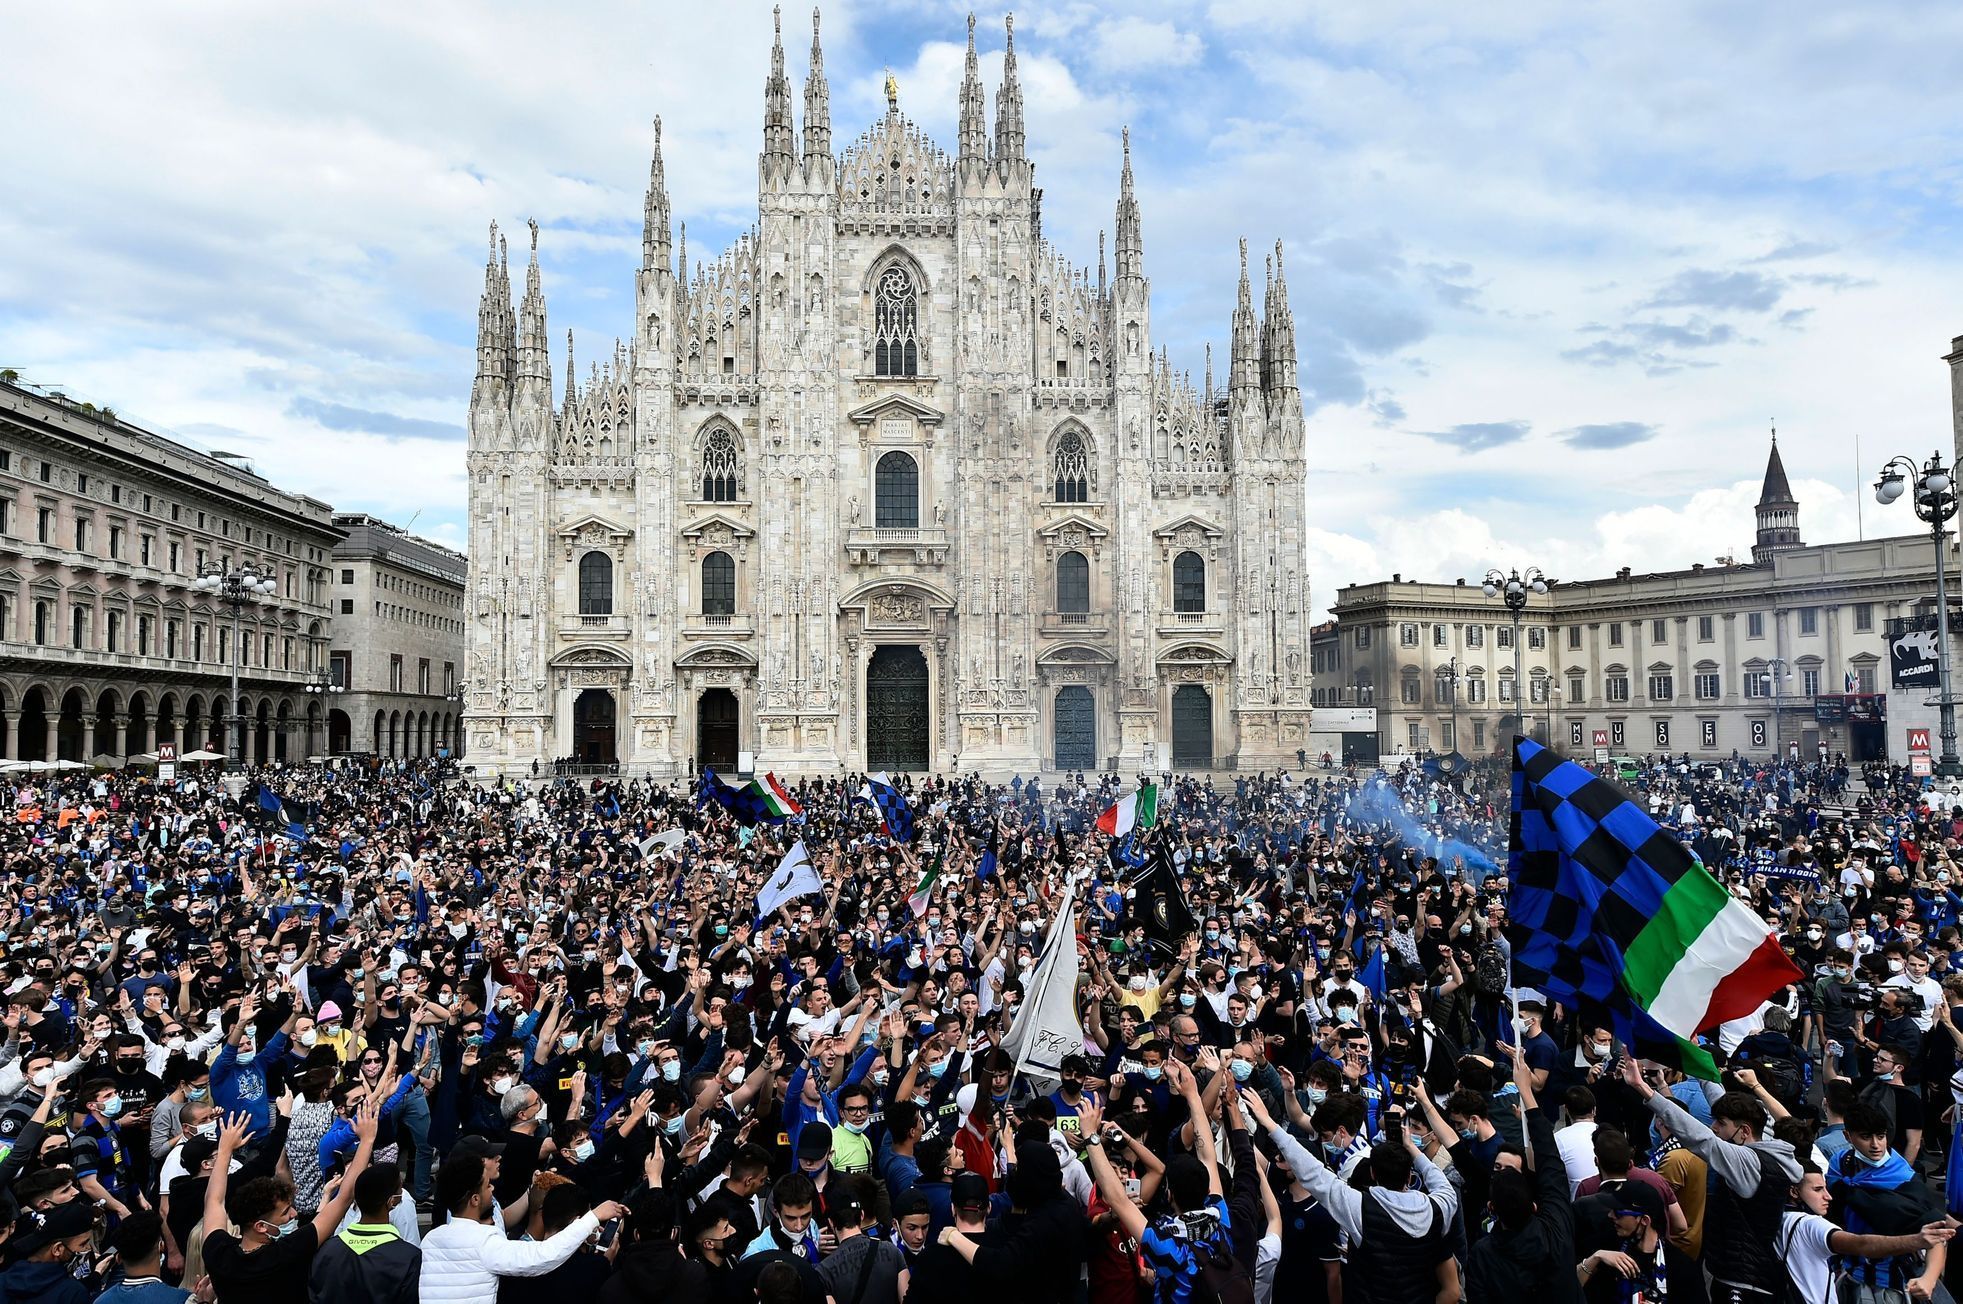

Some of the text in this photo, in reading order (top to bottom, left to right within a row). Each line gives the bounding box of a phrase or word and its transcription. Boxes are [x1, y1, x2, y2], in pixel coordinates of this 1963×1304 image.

[1899, 663, 1934, 677] ACCARDI
[1595, 733, 1606, 743] M
[1911, 733, 1928, 746] M
[160, 746, 174, 757] M
[1756, 865, 1787, 874] MILAN
[1796, 870, 1819, 878] ODIO
